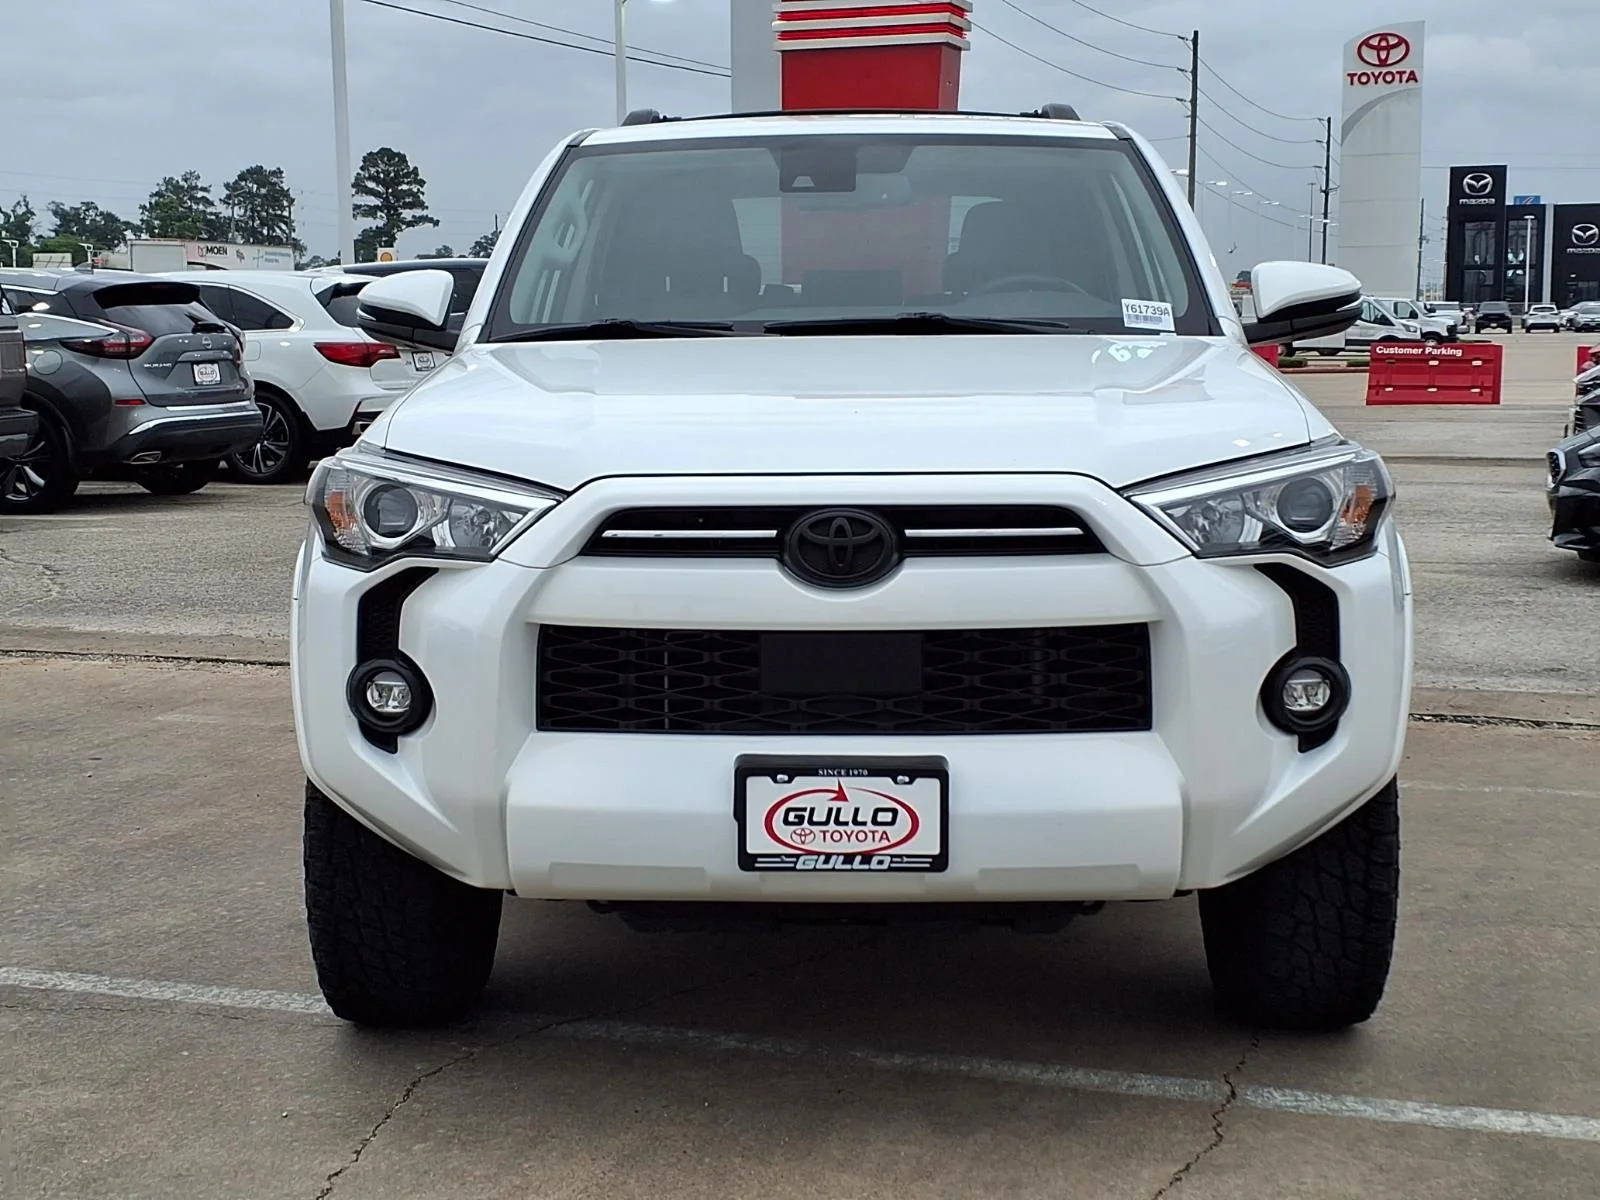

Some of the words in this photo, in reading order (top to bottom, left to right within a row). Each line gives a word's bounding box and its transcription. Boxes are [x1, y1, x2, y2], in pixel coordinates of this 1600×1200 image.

[1347, 70, 1418, 86] TOYOTA
[206, 246, 228, 256] MOEN
[1124, 303, 1170, 317] Y61739A
[1376, 346, 1423, 355] Customer
[1425, 347, 1462, 356] Parking
[818, 768, 847, 777] SINCE
[782, 807, 899, 827] GULLO
[820, 829, 891, 843] TOYOTA
[795, 855, 892, 870] GULLO
